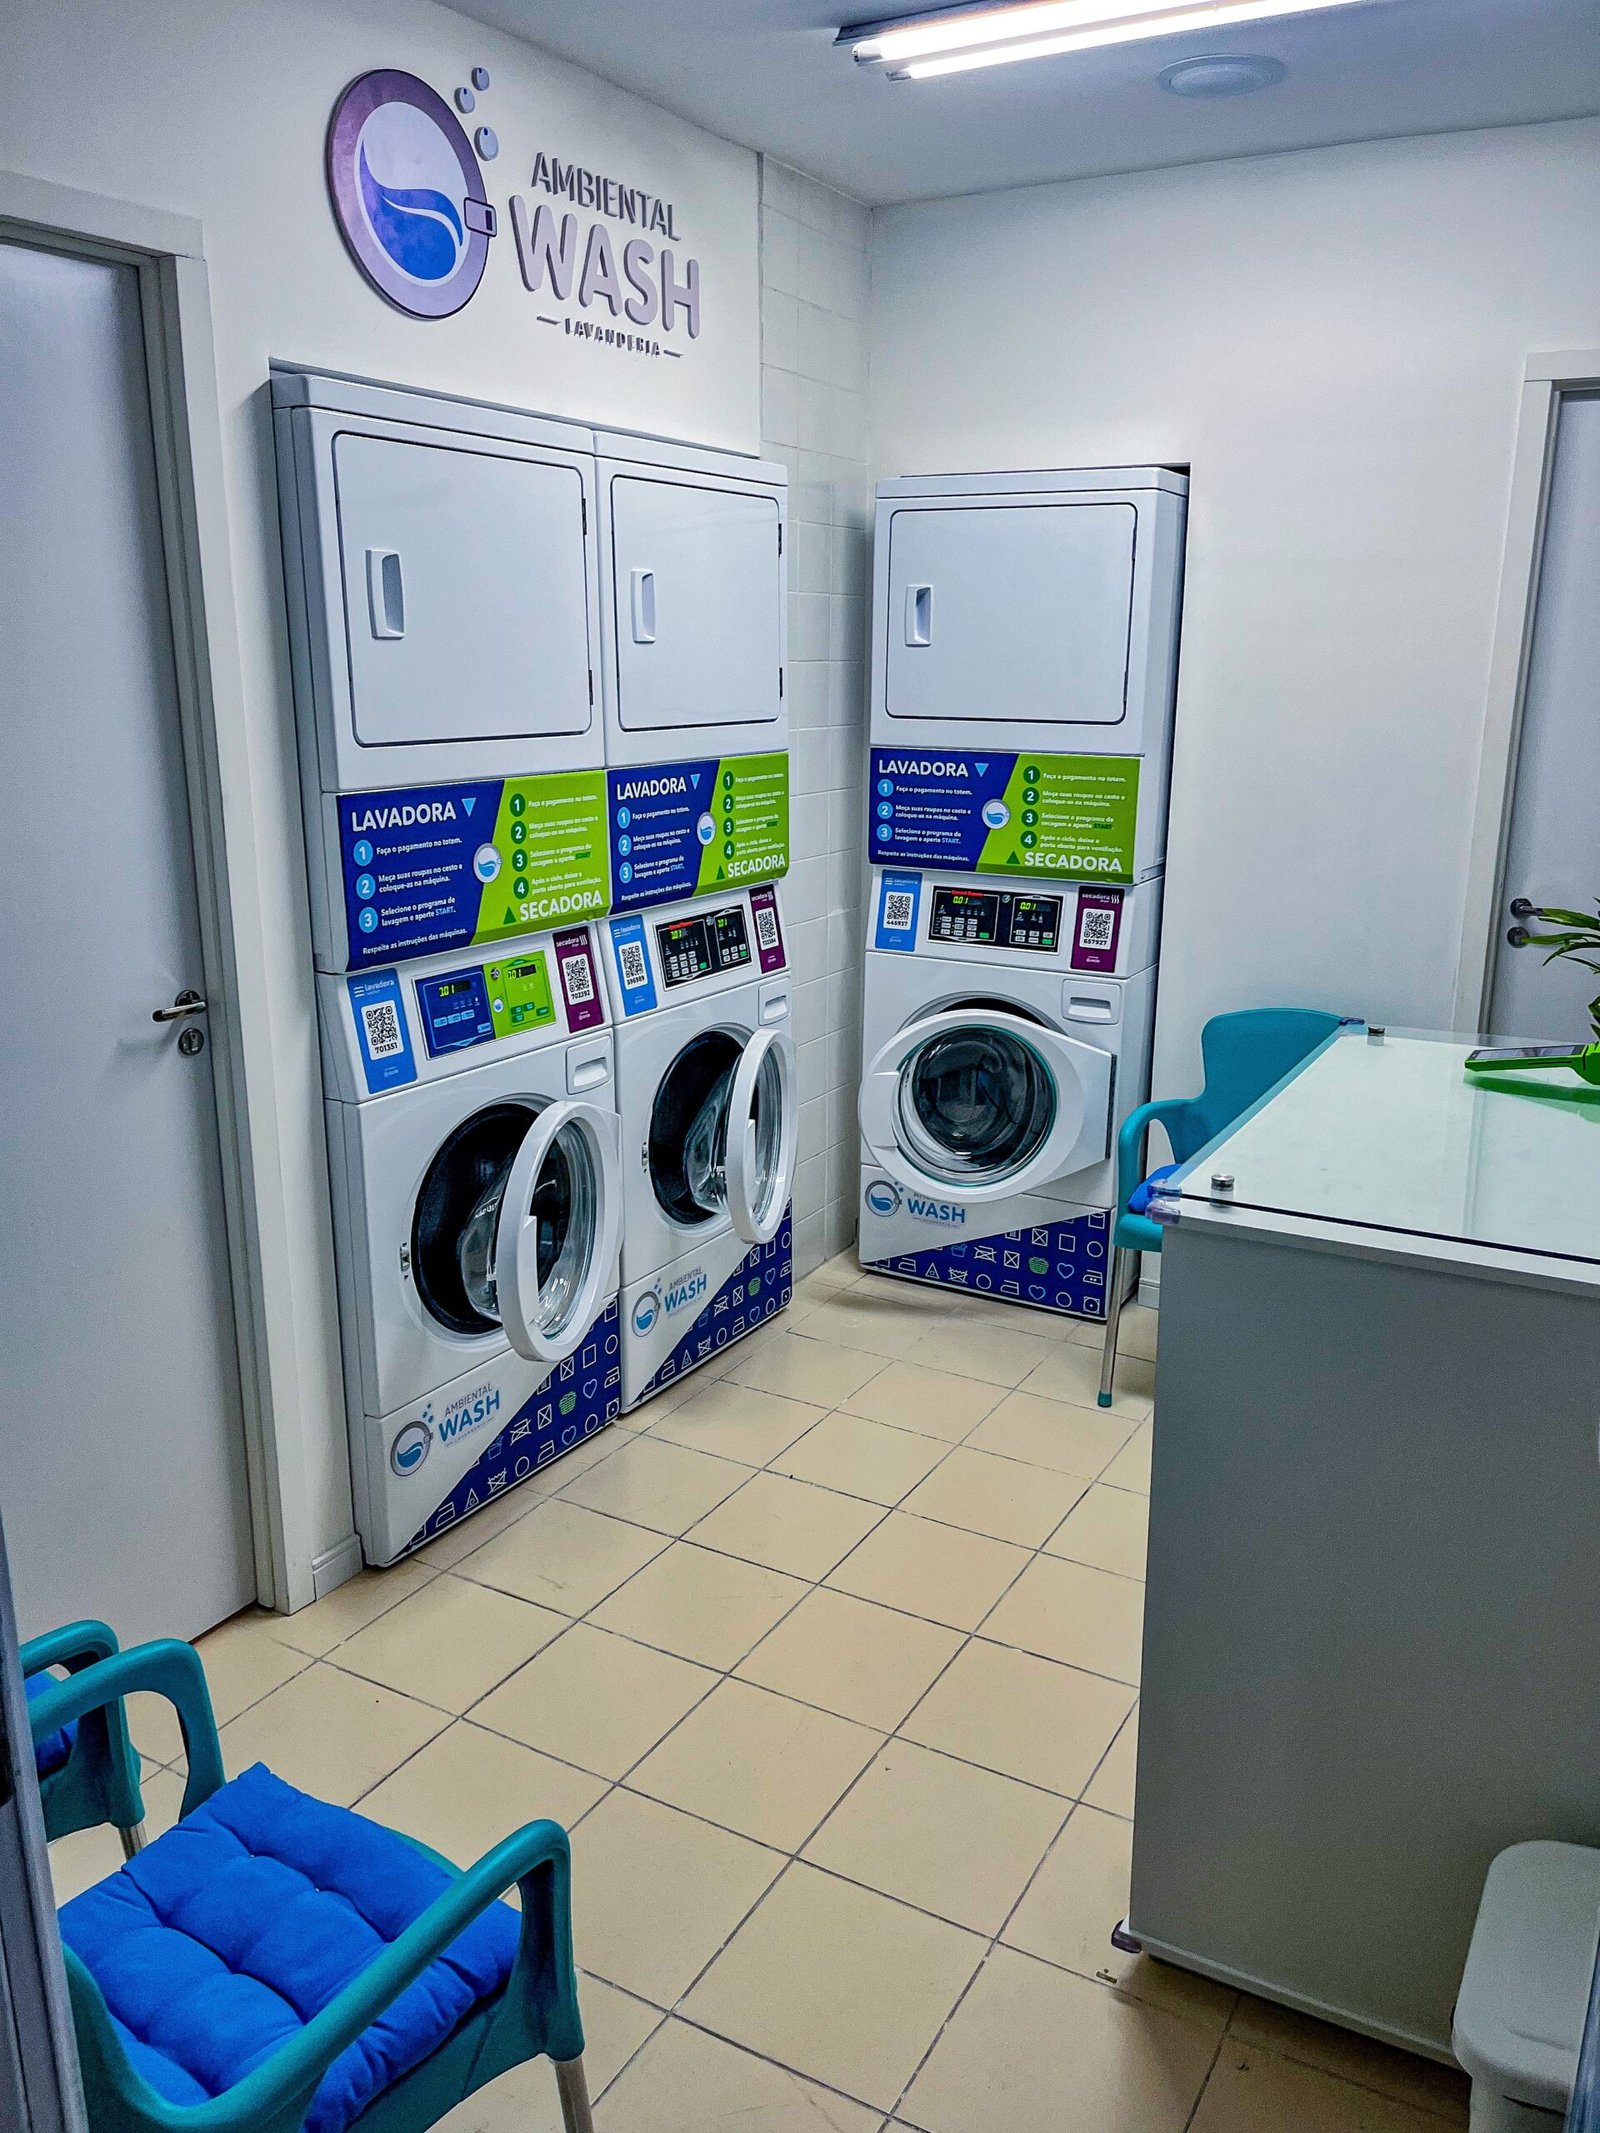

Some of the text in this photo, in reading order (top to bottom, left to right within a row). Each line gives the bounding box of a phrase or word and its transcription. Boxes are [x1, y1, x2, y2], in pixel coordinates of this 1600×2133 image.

[531, 152, 682, 241] AMBIENTAL
[509, 194, 700, 339] WASH
[564, 318, 660, 357] LAVANDERIA
[879, 759, 968, 777] LAVADORA
[726, 776, 730, 786] 1
[1028, 770, 1034, 780] 1
[617, 777, 686, 800] LAVADORA
[882, 783, 887, 792] 1
[1027, 791, 1034, 801] 2
[514, 799, 520, 811] 1
[726, 800, 731, 809] 2
[882, 806, 888, 815] 2
[352, 802, 456, 831] LAVADORA
[621, 812, 626, 823] 1
[1026, 813, 1033, 823] 3
[515, 826, 522, 839] 2
[726, 822, 731, 832] 3
[881, 828, 888, 837] 3
[622, 840, 627, 850] 2
[1024, 835, 1032, 844] 4
[359, 846, 366, 860] 1
[398, 842, 432, 853] pagamento
[726, 845, 731, 855] 4
[516, 855, 523, 866] 3
[728, 854, 785, 878] SECADORA
[1024, 852, 1122, 872] SECADORA
[624, 868, 628, 878] 3
[362, 880, 369, 893] 2
[412, 869, 432, 877] roupas
[379, 882, 413, 892] coloque-as
[423, 876, 450, 885] máquina.
[517, 882, 525, 894] 4
[520, 890, 603, 921] SECADORA
[364, 914, 372, 927] 3
[381, 906, 411, 916] Selecione
[418, 899, 446, 911] programa
[382, 917, 409, 926] lavagem
[415, 912, 434, 921] aperte
[436, 906, 456, 916] START.
[363, 944, 389, 954] Respeite
[398, 936, 427, 946] instruções
[440, 929, 467, 938] máquinas.
[556, 937, 579, 947] secadora
[365, 980, 394, 989] lavadora
[375, 1042, 398, 1054] 701351
[907, 1198, 965, 1223] WASH
[665, 1274, 706, 1312] WASH
[445, 1383, 493, 1417] AMBIENTAL
[439, 1390, 500, 1442] WASH
